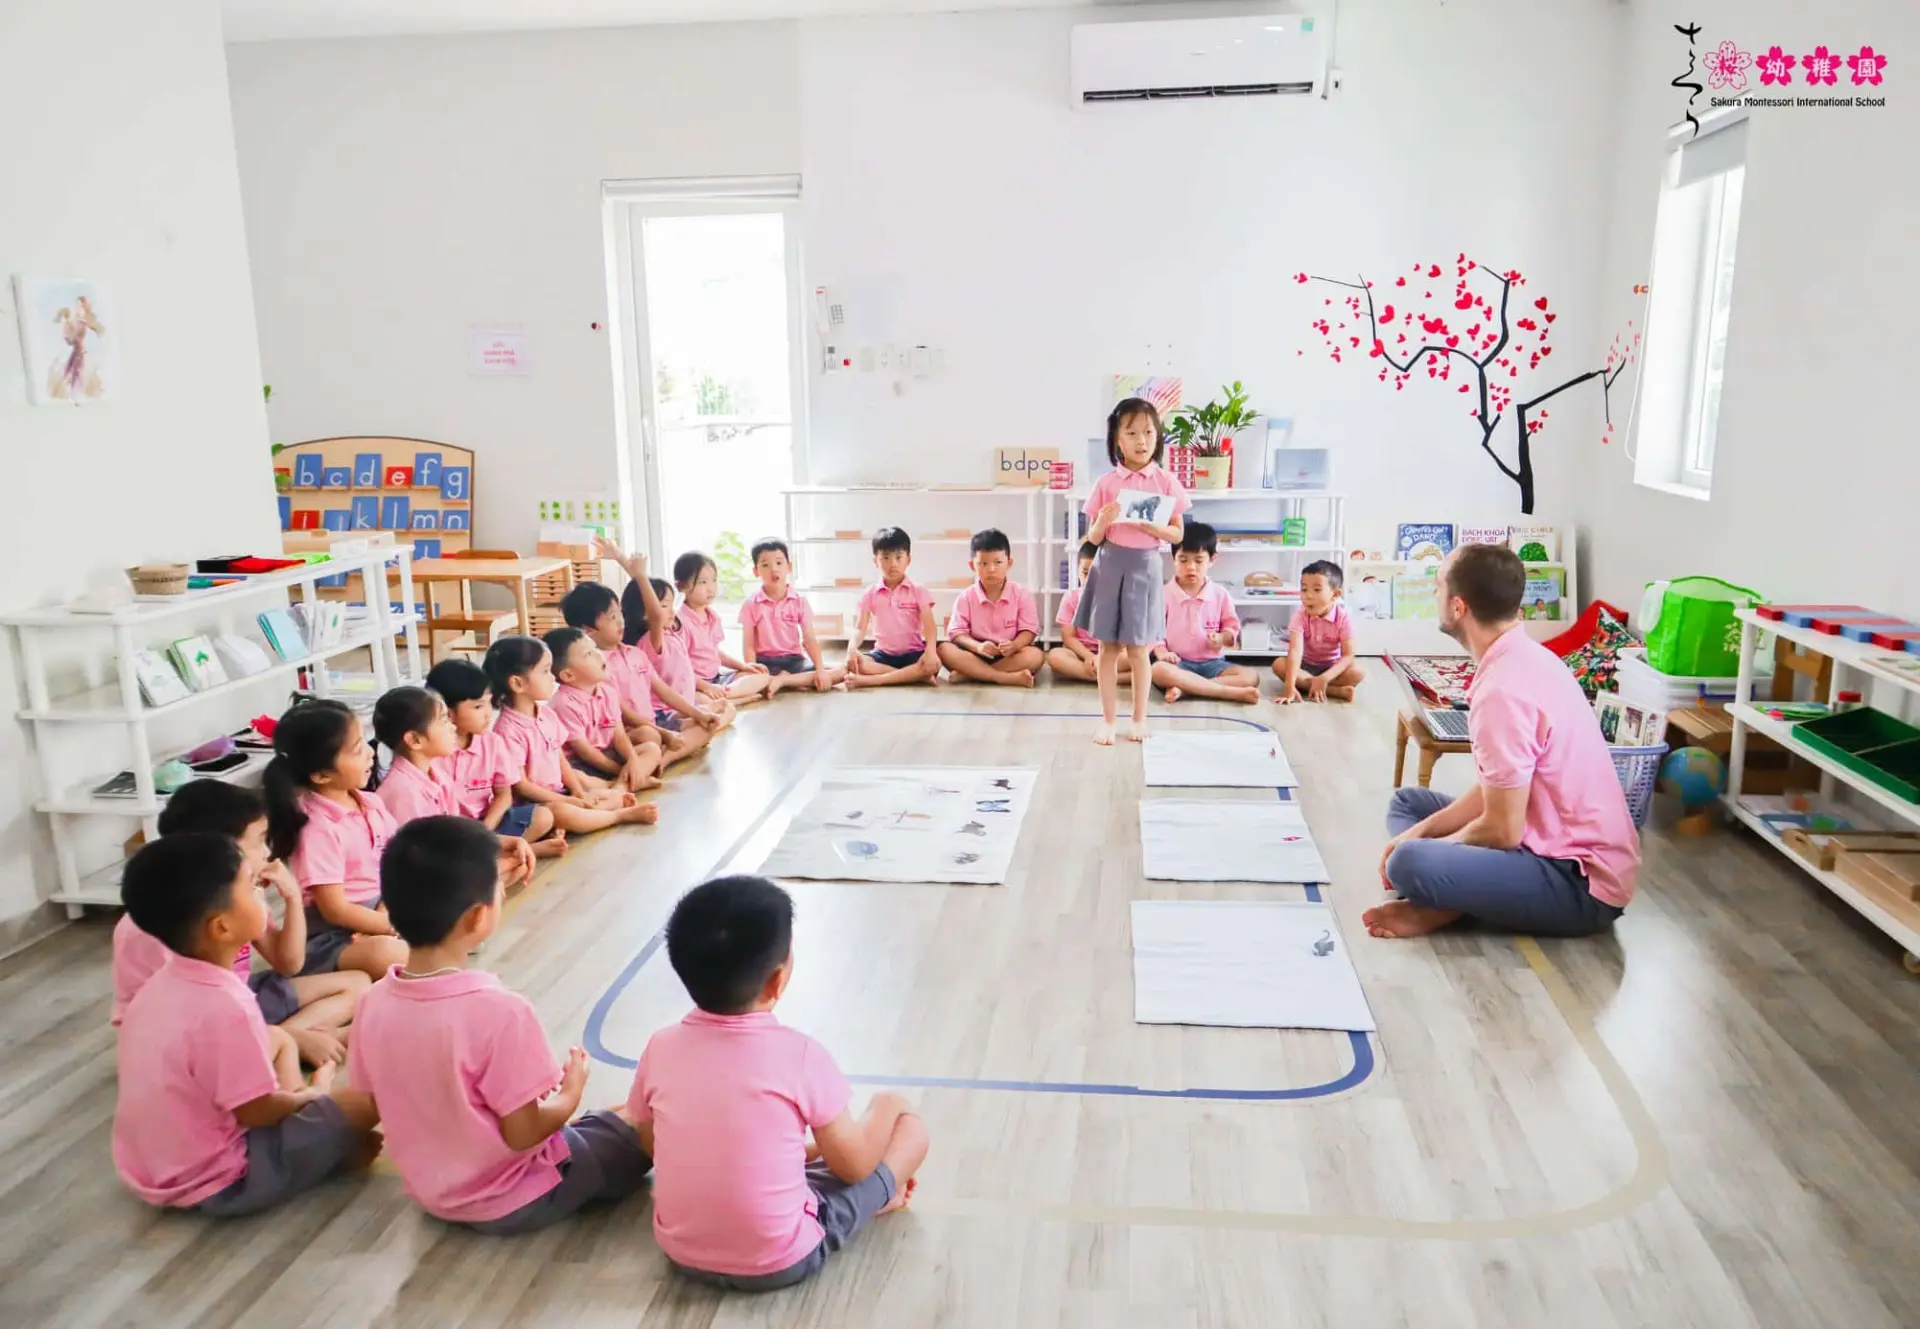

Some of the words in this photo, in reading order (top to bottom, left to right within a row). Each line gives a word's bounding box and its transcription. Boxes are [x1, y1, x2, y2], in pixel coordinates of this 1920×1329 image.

[300, 459, 314, 485] b
[329, 471, 344, 485] c
[358, 459, 375, 486] d
[391, 471, 406, 485] e
[421, 457, 438, 486] f
[447, 471, 463, 499] g
[355, 502, 372, 529] k
[412, 513, 436, 529] m
[447, 514, 462, 529] n
